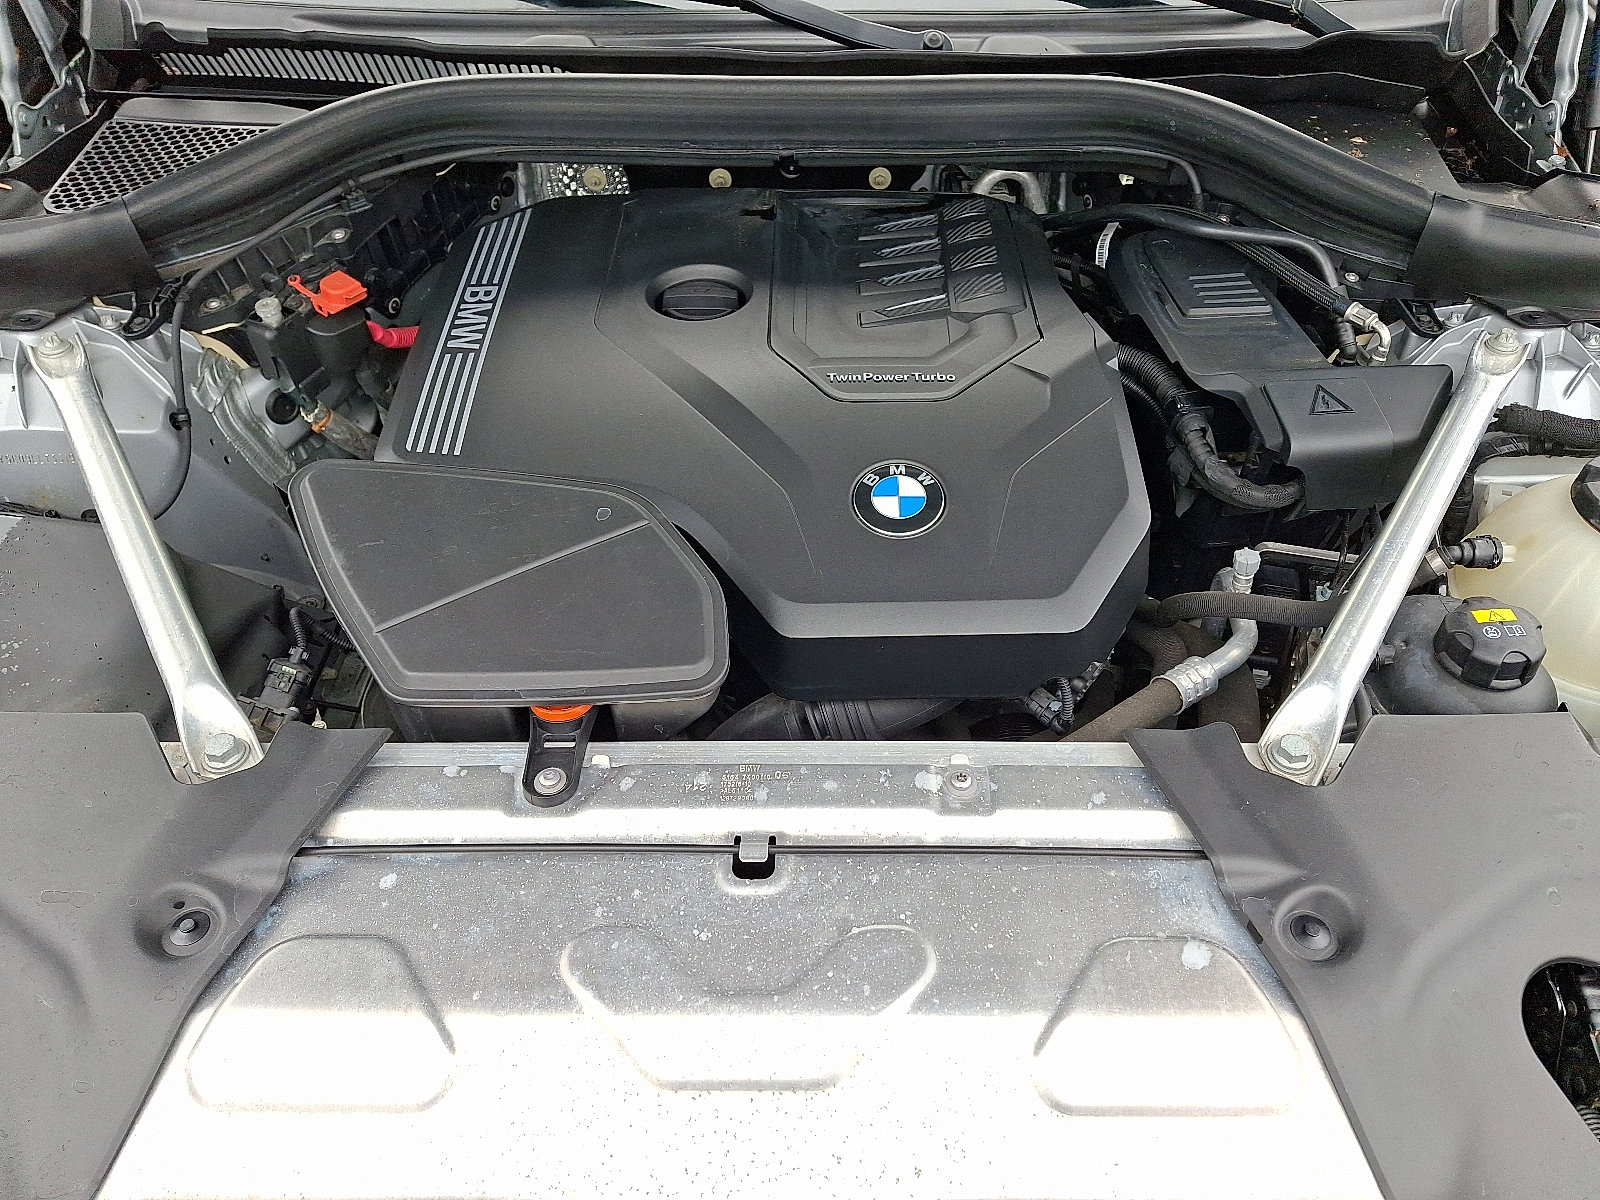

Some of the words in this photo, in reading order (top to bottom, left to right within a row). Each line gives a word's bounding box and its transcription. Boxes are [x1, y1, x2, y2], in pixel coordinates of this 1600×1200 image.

[446, 285, 499, 350] BMW
[911, 372, 956, 382] Turbo
[862, 464, 935, 487] BMW
[739, 764, 761, 773] BMW
